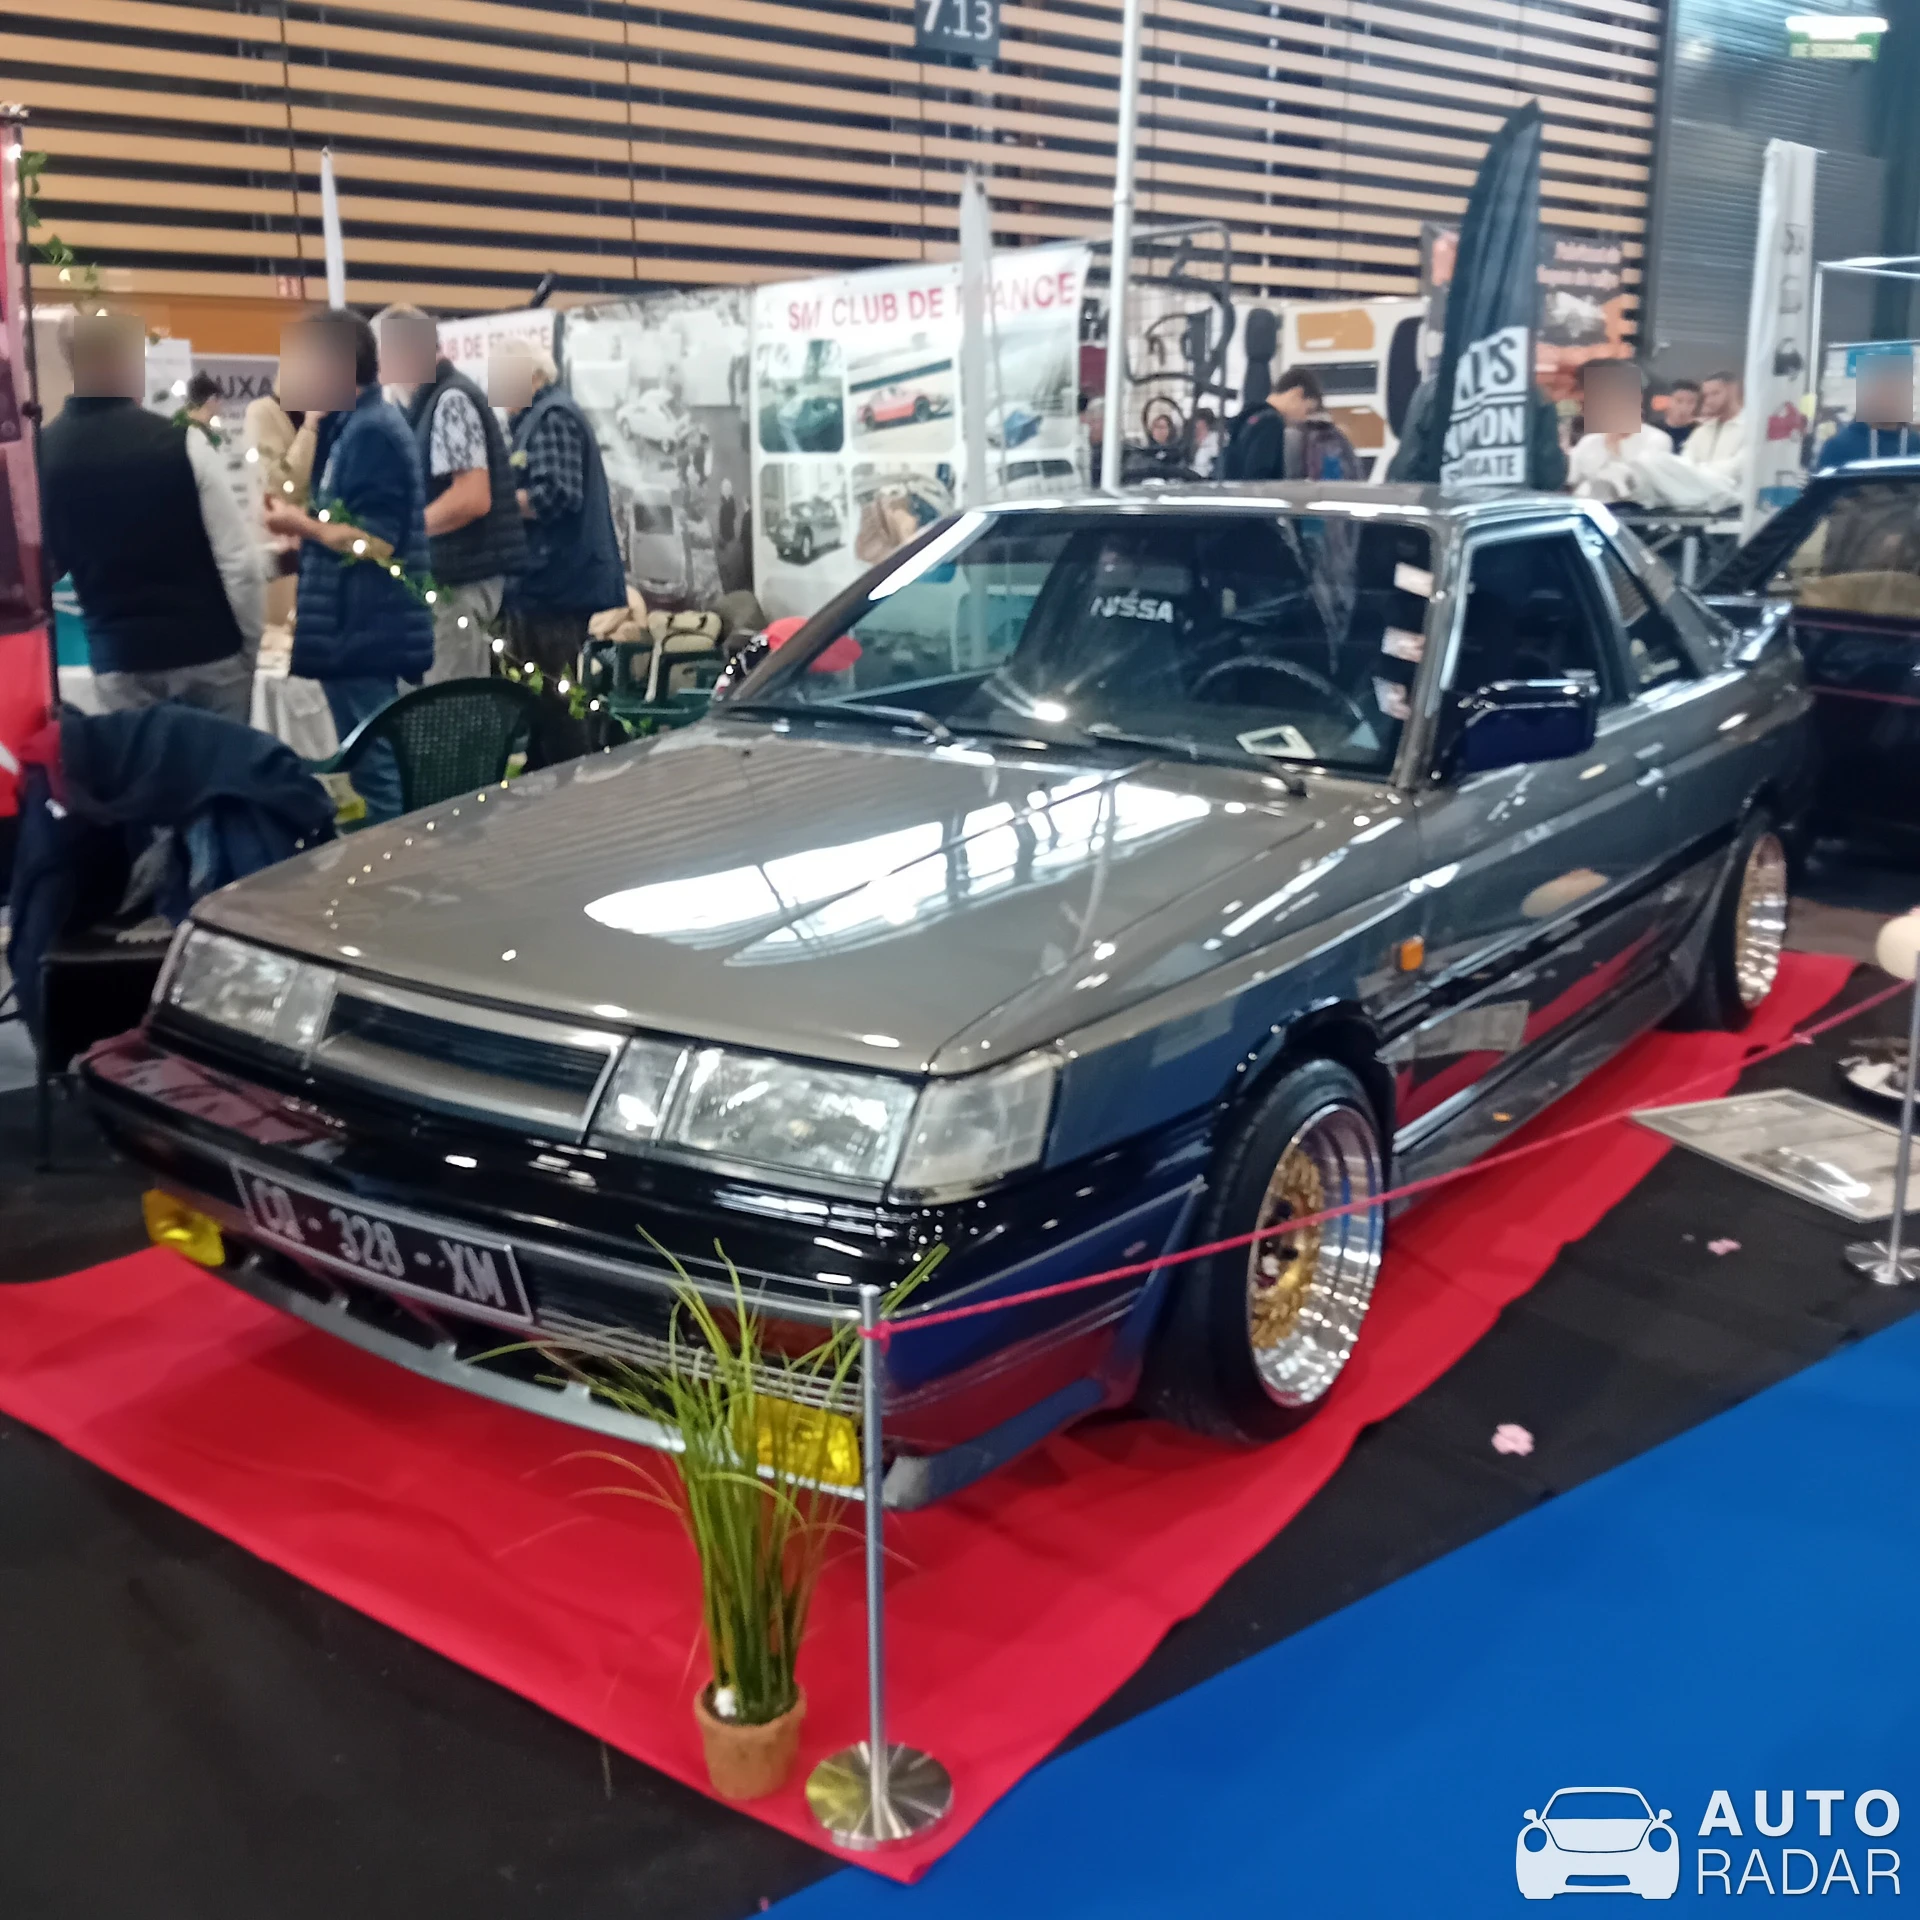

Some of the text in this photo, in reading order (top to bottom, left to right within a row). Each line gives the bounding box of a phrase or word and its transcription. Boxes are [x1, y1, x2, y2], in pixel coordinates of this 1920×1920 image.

[922, 0, 993, 40] 7.13
[831, 292, 899, 327] CLUB
[908, 287, 943, 320] DE
